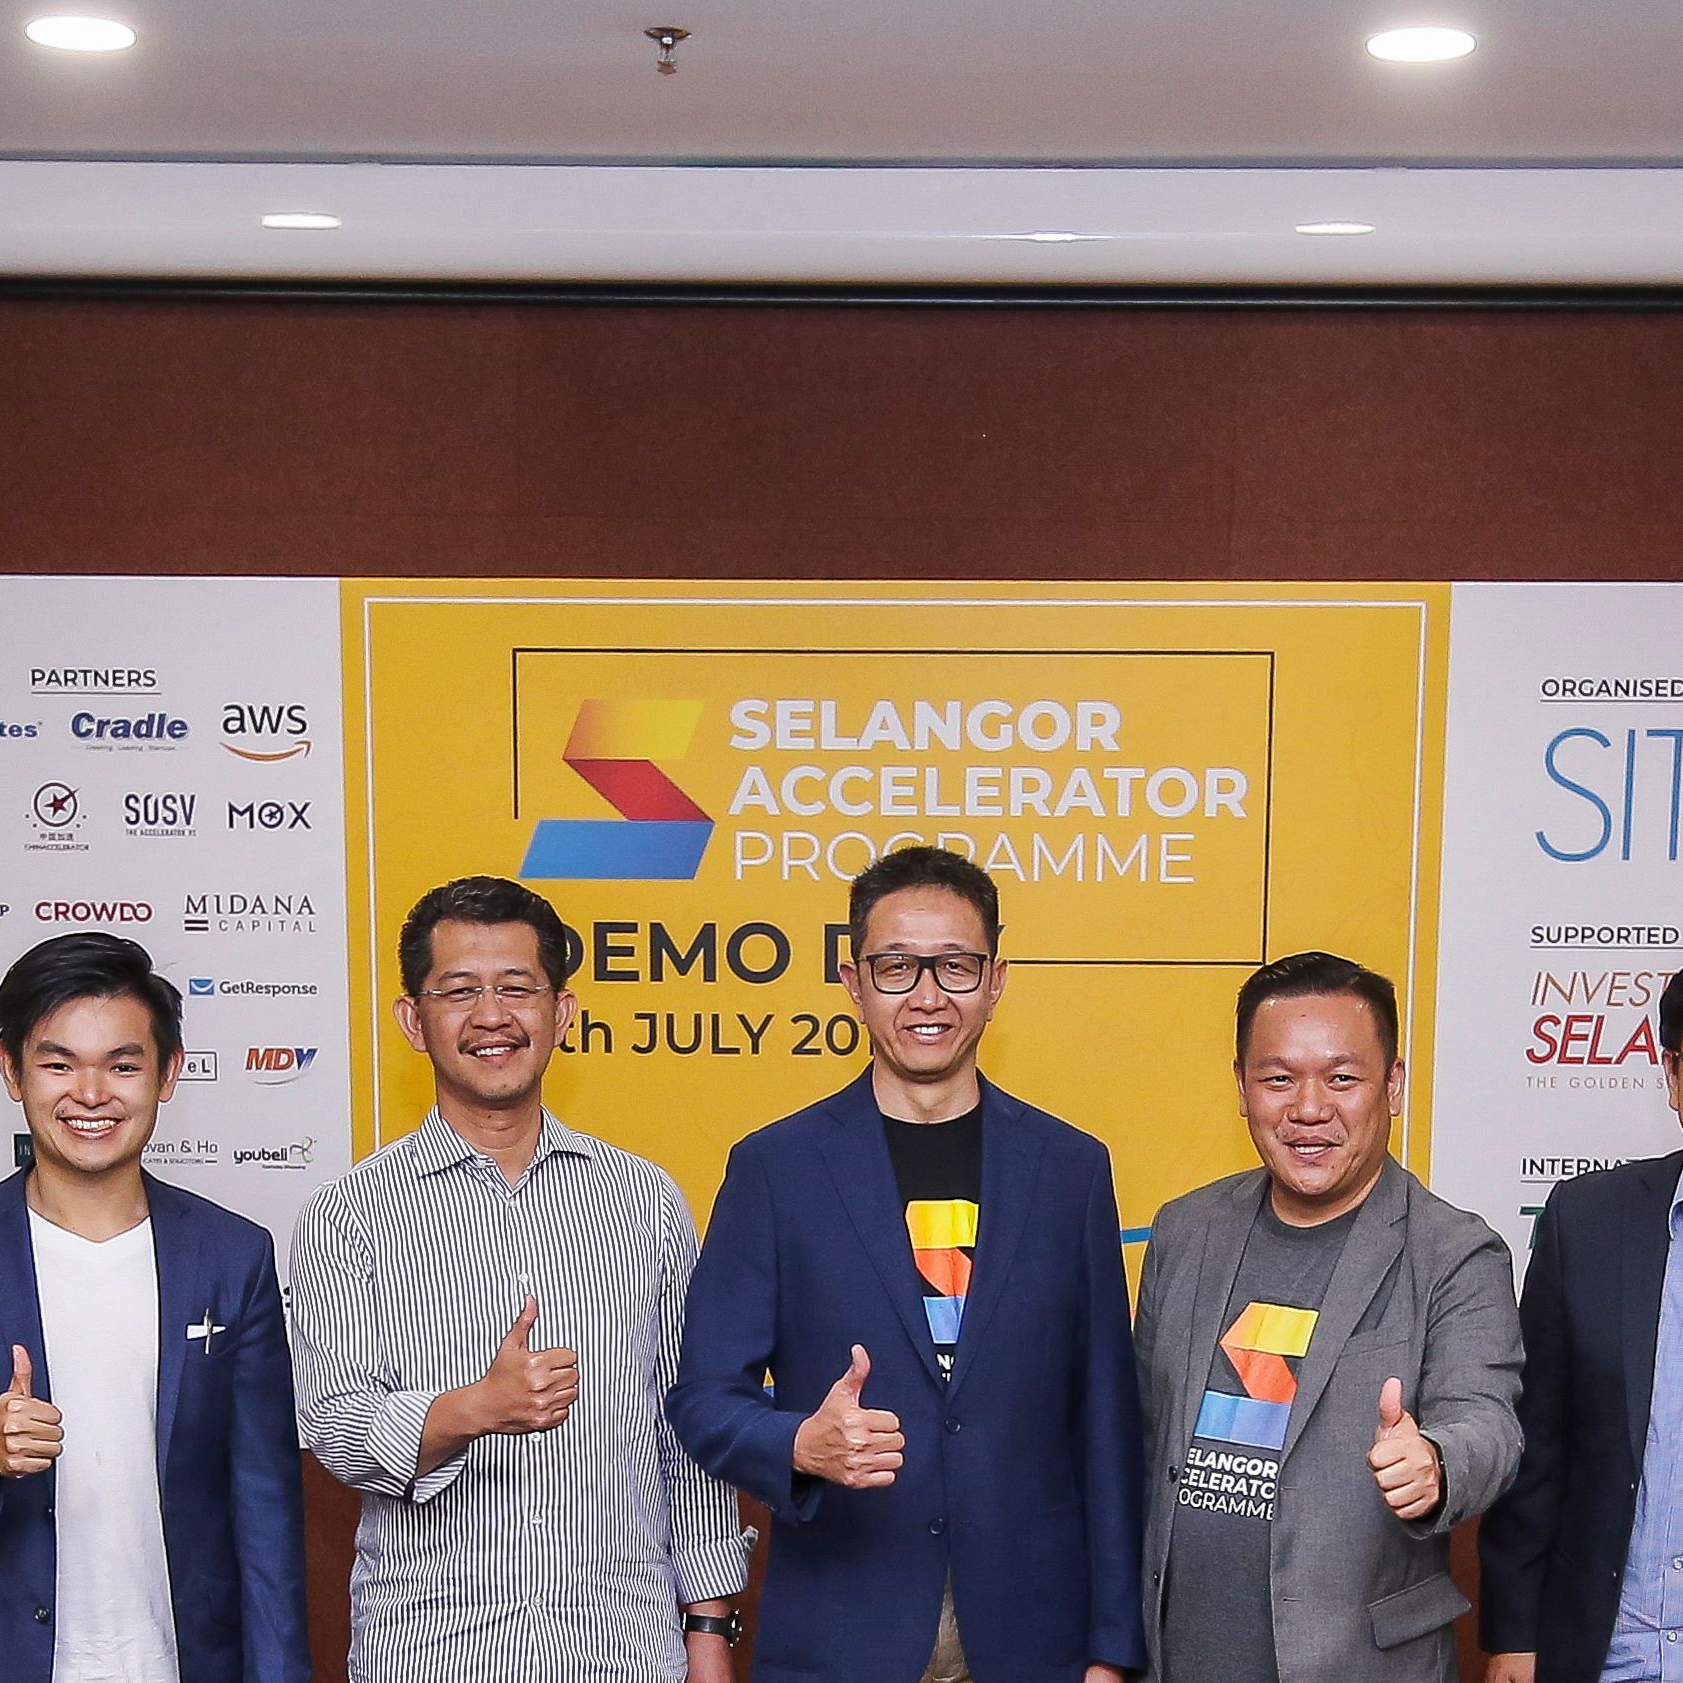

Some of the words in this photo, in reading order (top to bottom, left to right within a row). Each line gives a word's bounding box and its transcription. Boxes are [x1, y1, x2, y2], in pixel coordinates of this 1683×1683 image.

[31, 669, 157, 688] PARTNERS
[71, 712, 188, 739] Cradle
[222, 703, 307, 735] aws
[728, 697, 1121, 753] SELANGOR
[728, 766, 1249, 818] ACCELERATOR
[124, 794, 196, 825] SOSV
[227, 801, 312, 831] MOX
[35, 901, 152, 922] CROWDO
[185, 893, 316, 915] MIDANA
[220, 919, 317, 932] CAPITAL
[1531, 926, 1680, 946] SUPPORTED
[220, 980, 318, 998] GetResponse
[631, 1011, 775, 1056] JULY
[1527, 1076, 1558, 1089] THE
[1569, 1076, 1645, 1089] GOLDEN
[234, 1148, 288, 1164] youbell
